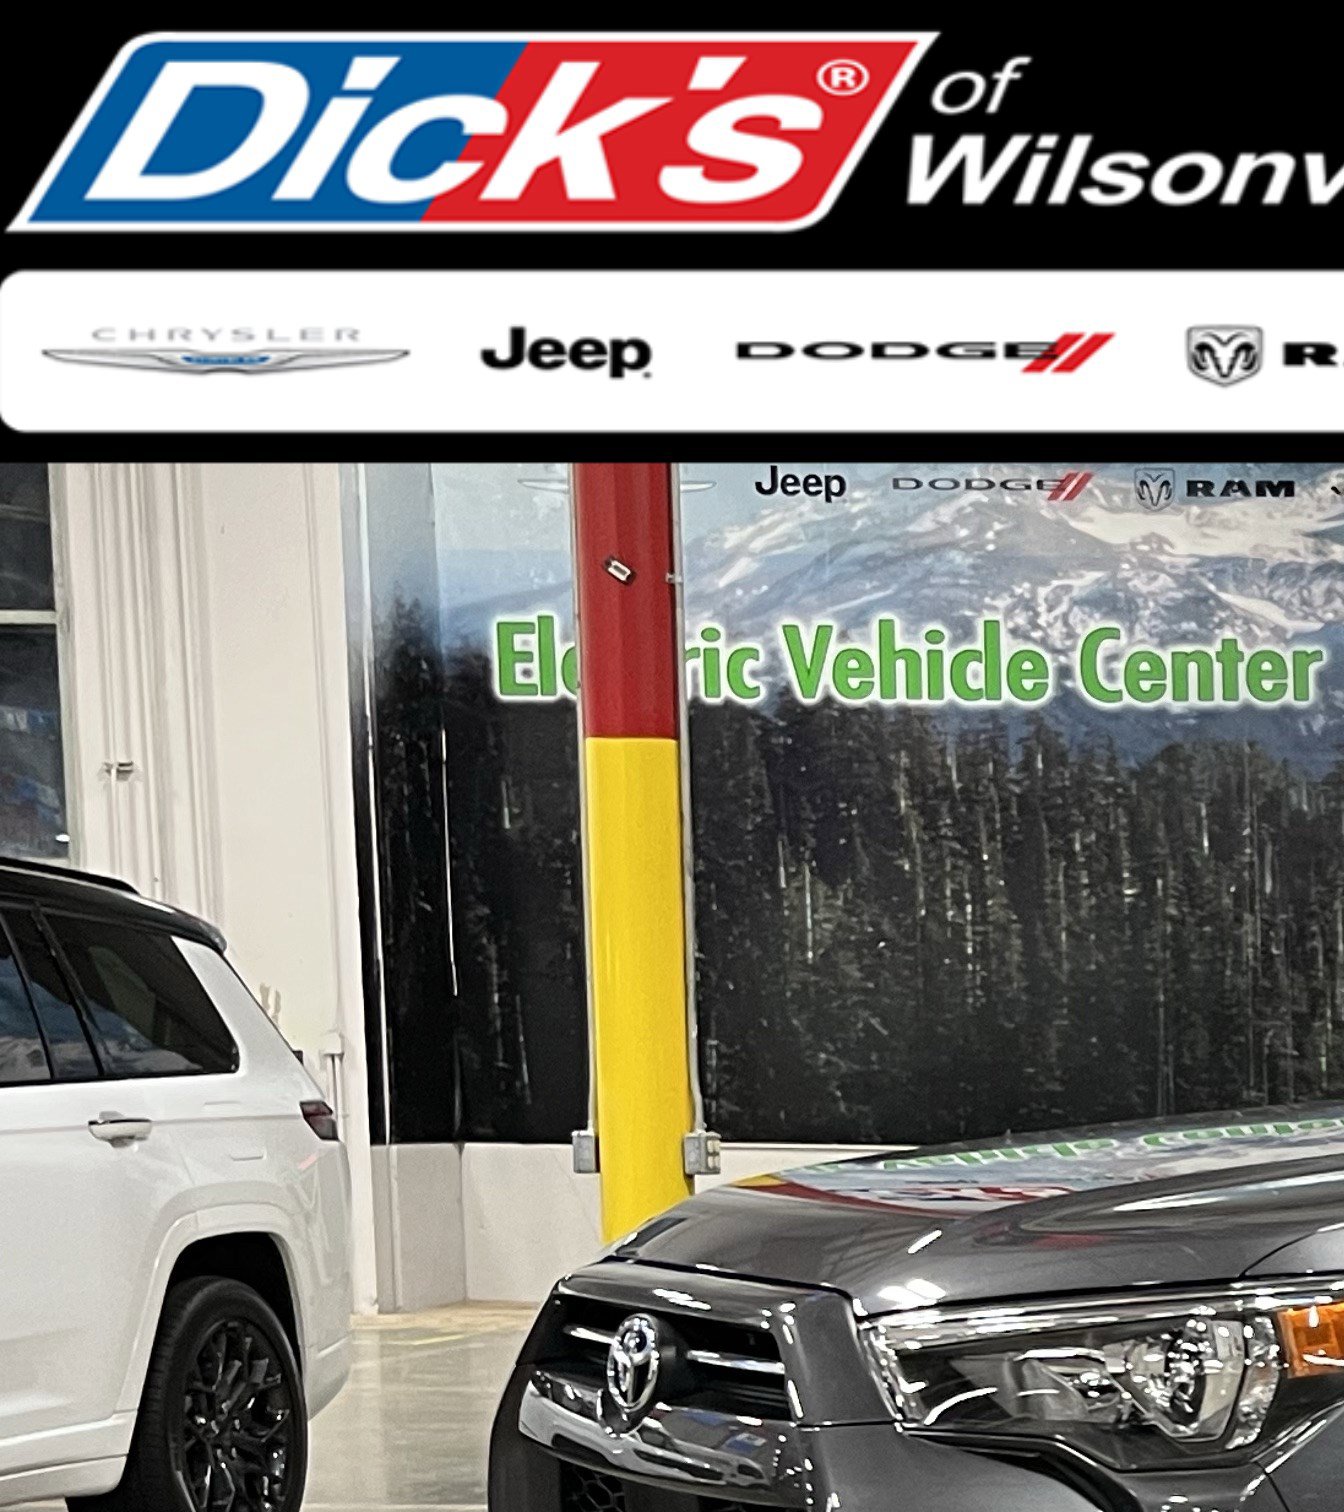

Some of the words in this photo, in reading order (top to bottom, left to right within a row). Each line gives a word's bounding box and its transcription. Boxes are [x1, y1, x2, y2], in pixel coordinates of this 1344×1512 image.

[755, 465, 847, 502] Jeep
[891, 476, 1062, 492] DODGE
[1185, 479, 1295, 498] RAM
[496, 614, 761, 700] Elic
[782, 618, 1049, 702] Vehicle
[1079, 626, 1324, 703] Center
